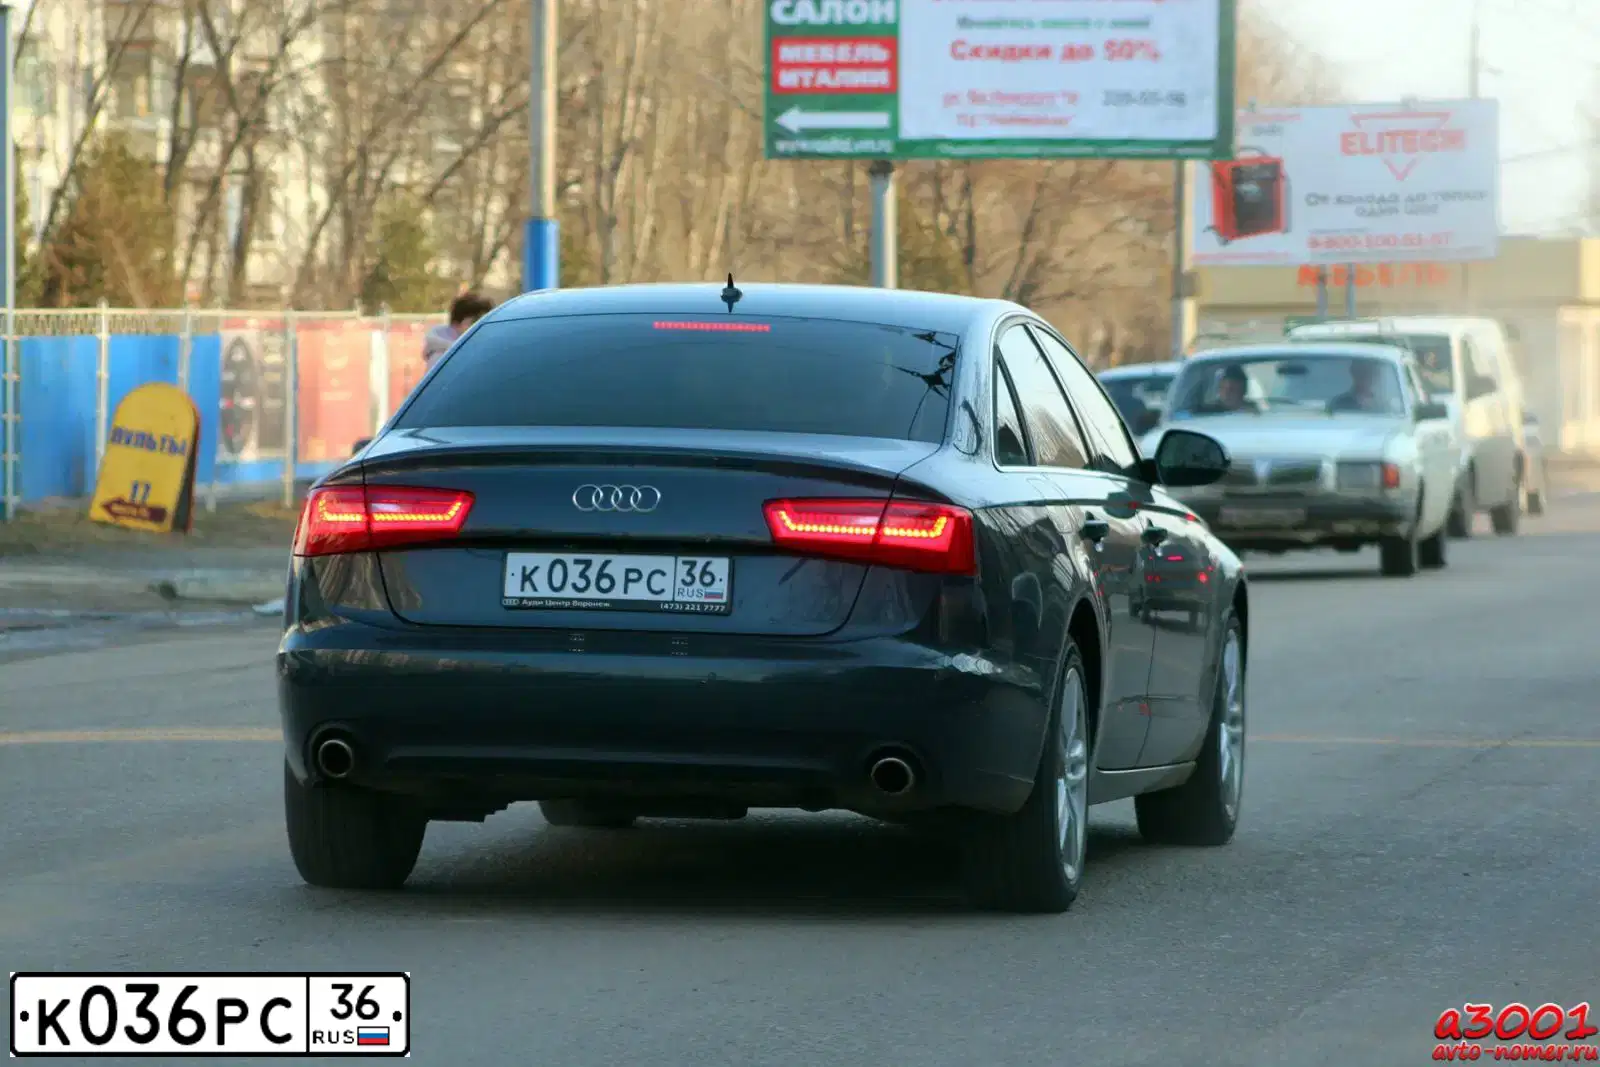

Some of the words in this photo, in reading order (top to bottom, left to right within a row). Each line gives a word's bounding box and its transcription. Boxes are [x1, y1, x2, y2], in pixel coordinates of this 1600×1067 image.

[770, 0, 896, 25] САЛОН
[778, 44, 890, 63] МЕБЕЛЬ
[950, 39, 1053, 61] Скидки
[1060, 43, 1095, 62] до
[1103, 39, 1162, 62] 50%
[778, 69, 890, 88] ИТАЛИИ
[1340, 130, 1467, 156] ELITECH
[519, 557, 668, 596] К036РС
[680, 559, 716, 588] 36
[521, 599, 544, 607] Ауди
[545, 599, 571, 607] Центр
[677, 587, 704, 598] RUS
